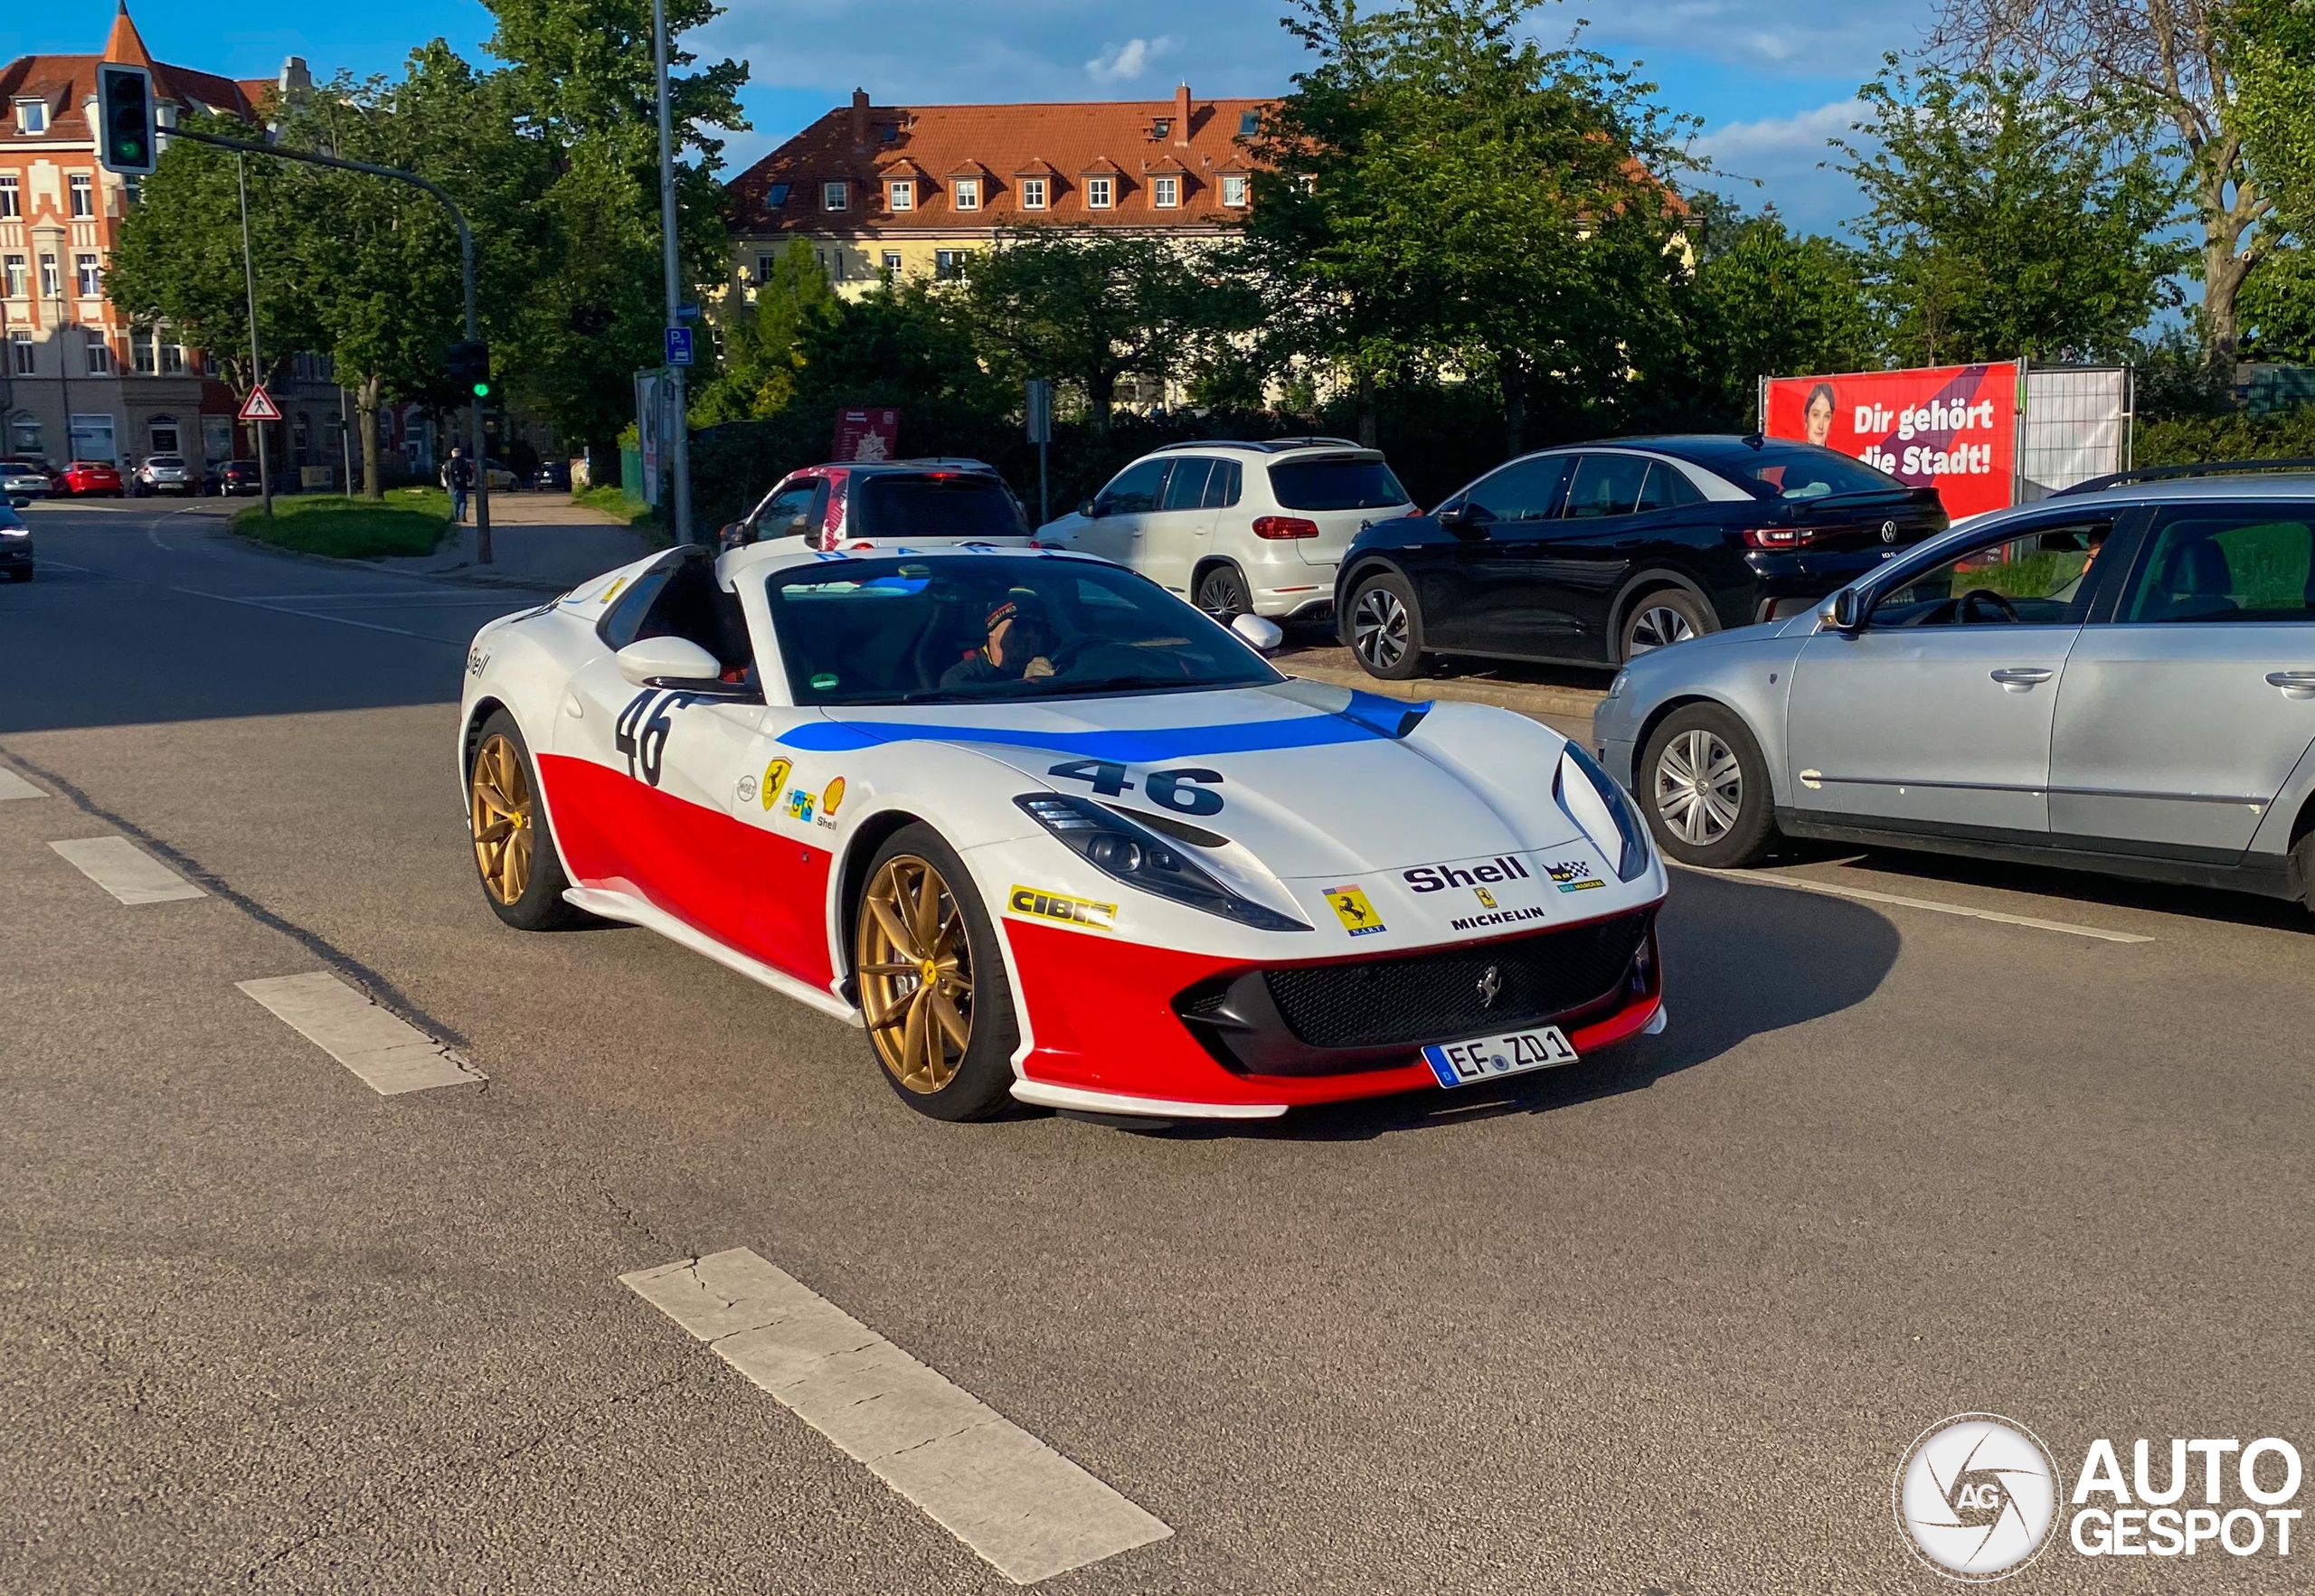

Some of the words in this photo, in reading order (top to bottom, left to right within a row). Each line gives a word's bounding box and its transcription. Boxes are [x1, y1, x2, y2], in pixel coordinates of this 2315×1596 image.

[670, 331, 681, 345] P
[1854, 402, 1894, 434] Dir
[1897, 398, 1994, 440] gehört
[1901, 443, 1991, 475] Stadt!
[616, 688, 699, 787] 46
[1047, 760, 1224, 816] 46
[792, 795, 814, 817] GTS
[817, 816, 842, 831] Shell
[1403, 856, 1530, 892] Shell
[1450, 907, 1545, 930] MICHELIN
[1447, 1043, 1488, 1077] EF
[1443, 1072, 1451, 1081] D
